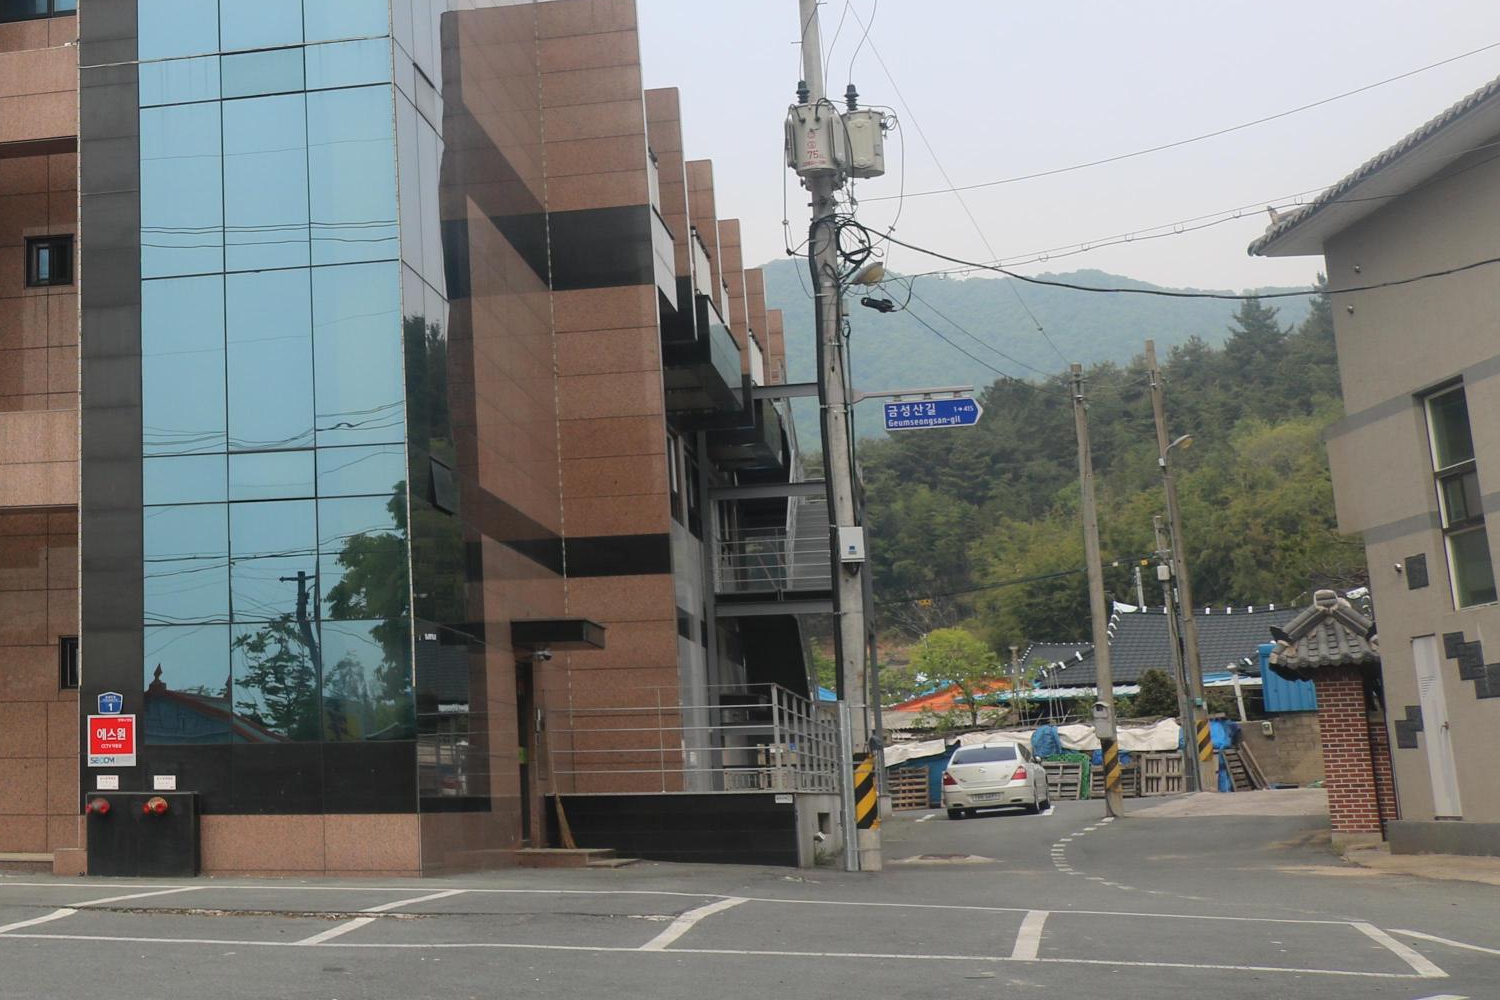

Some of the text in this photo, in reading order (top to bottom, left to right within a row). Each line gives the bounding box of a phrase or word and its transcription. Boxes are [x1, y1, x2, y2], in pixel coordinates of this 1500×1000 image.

[888, 403, 935, 417] 금성산길
[889, 416, 961, 426] Geumseongsan-gil
[108, 703, 113, 711] 1
[97, 728, 126, 740] 에스원
